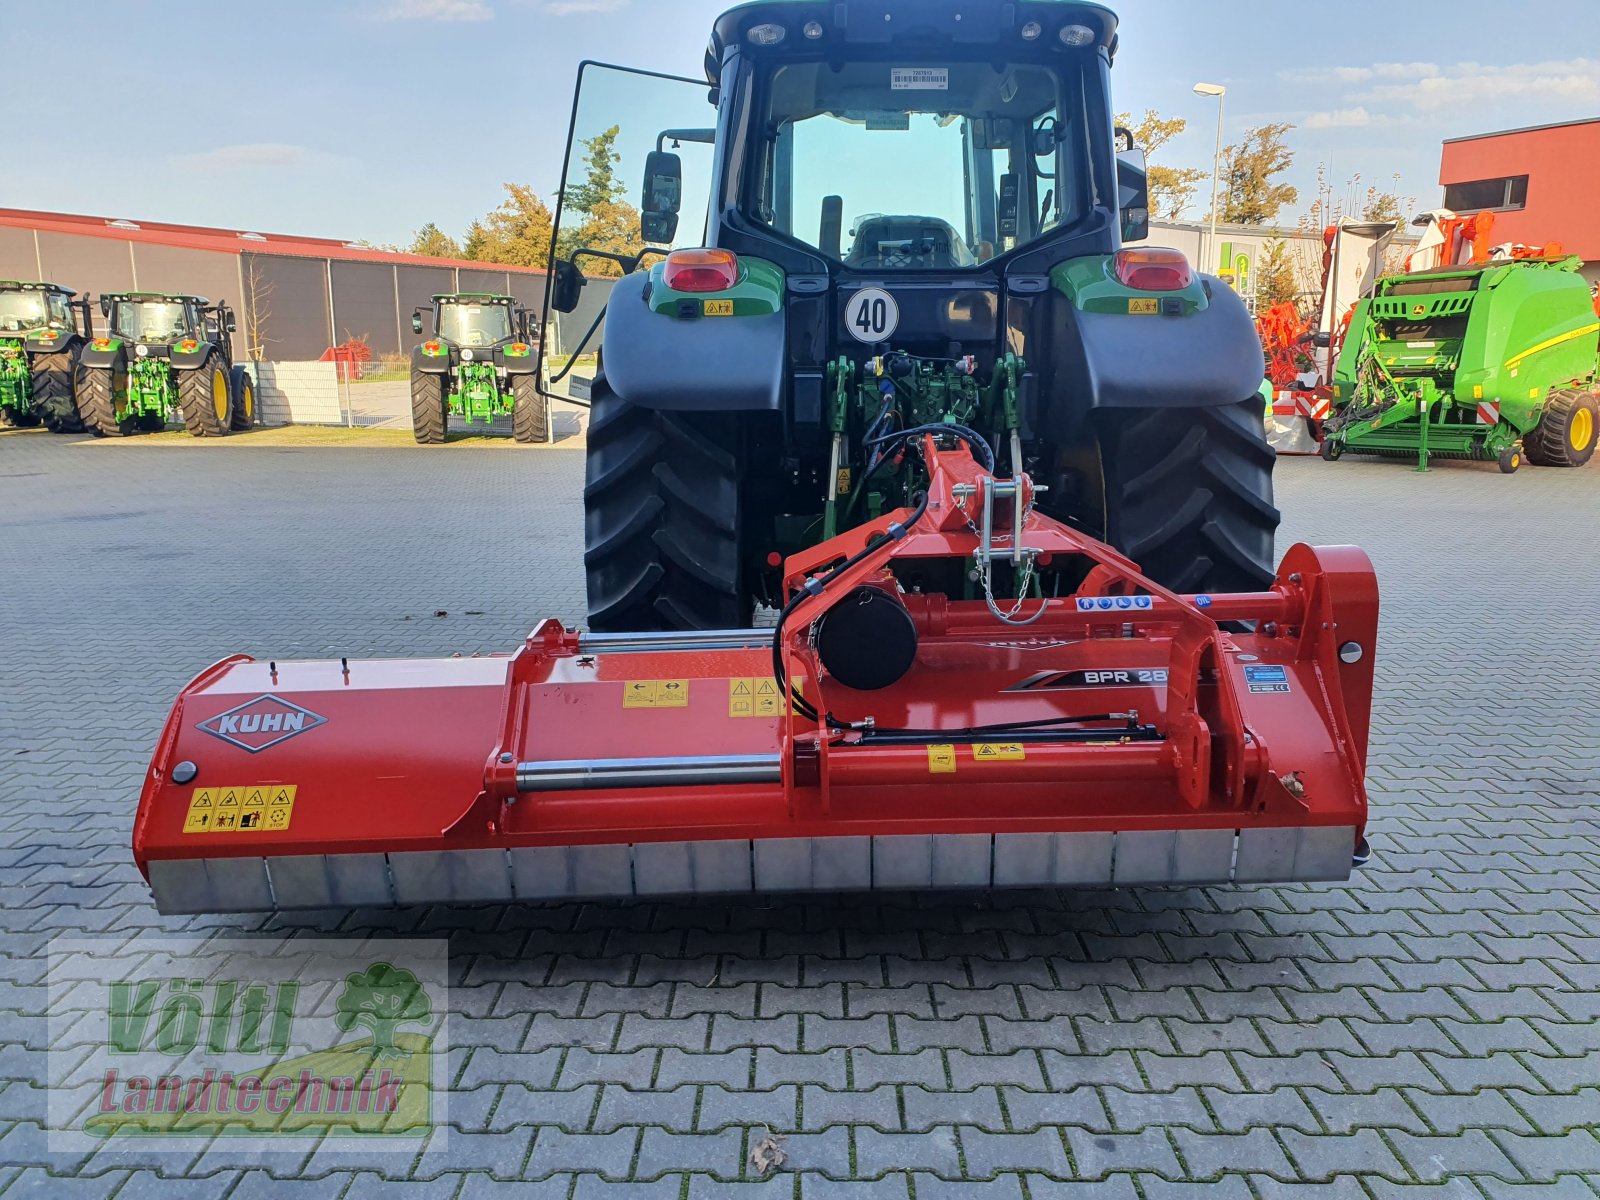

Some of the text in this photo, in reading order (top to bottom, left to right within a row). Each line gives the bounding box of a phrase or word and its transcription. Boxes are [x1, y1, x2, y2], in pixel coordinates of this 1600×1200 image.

[856, 298, 886, 333] 40
[1196, 596, 1210, 605] OIL
[1084, 671, 1130, 683] BPR
[218, 712, 305, 734] KUHN
